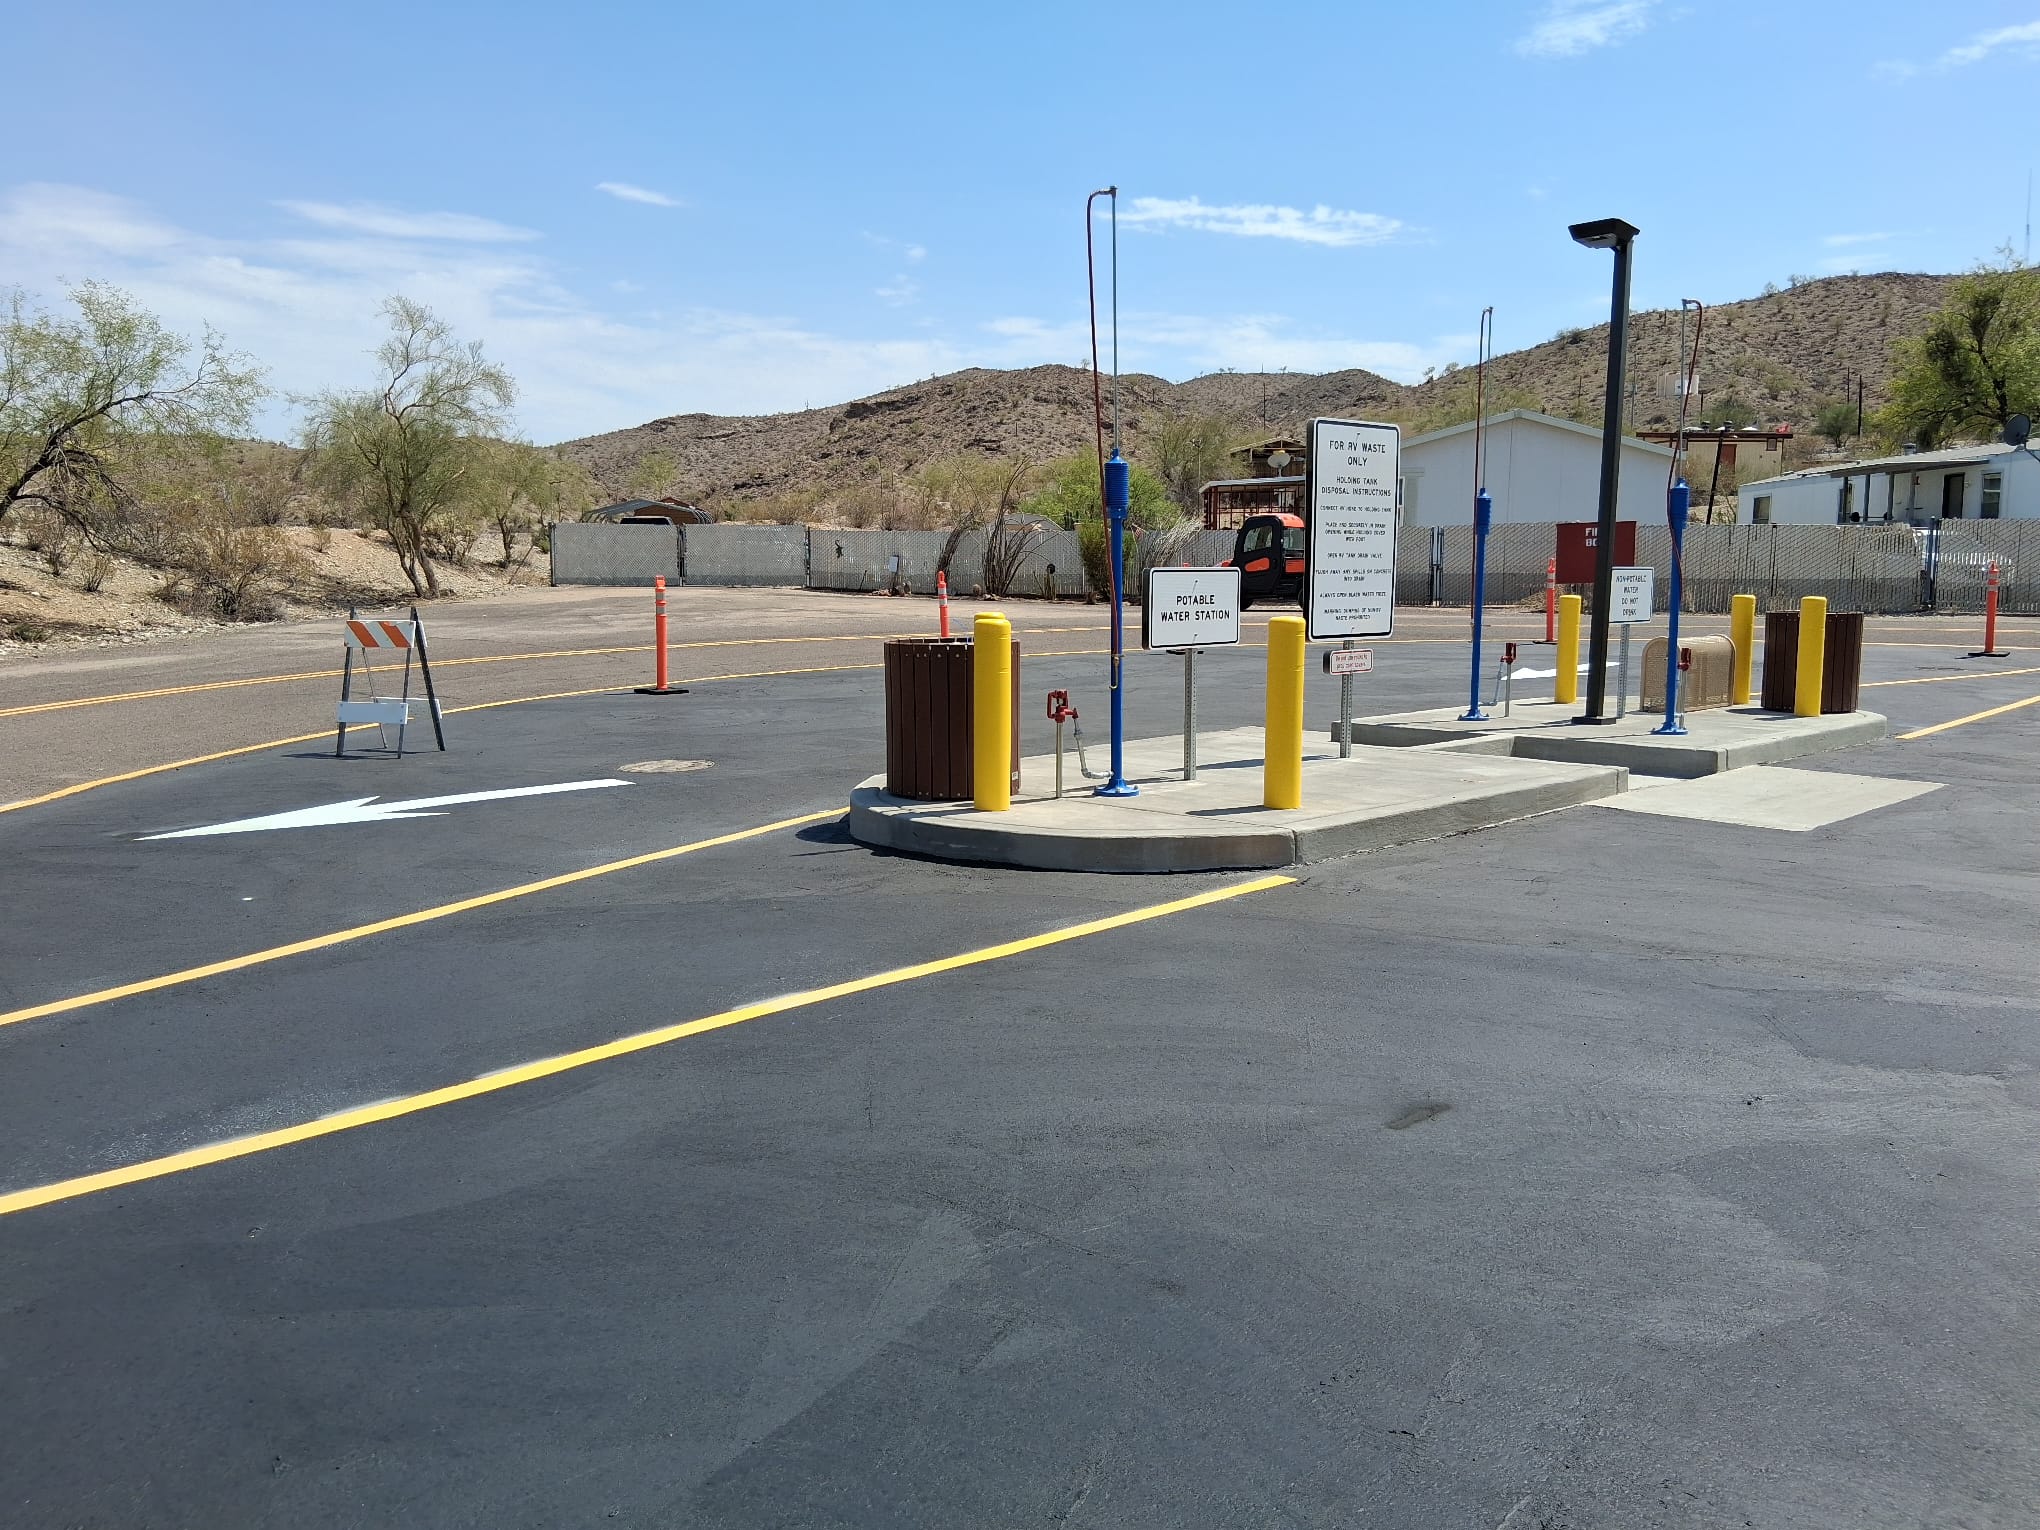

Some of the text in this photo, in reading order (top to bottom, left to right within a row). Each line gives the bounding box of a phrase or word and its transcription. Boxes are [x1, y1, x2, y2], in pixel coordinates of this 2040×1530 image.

[1329, 440, 1386, 453] FOR RV WASTE
[1347, 456, 1368, 466] ONLY
[1336, 475, 1378, 486] HOLDING TANK
[1321, 486, 1391, 497] DISPOSAL INSTRUCTIONS
[1615, 575, 1647, 583] NON-POTABLE
[1623, 586, 1639, 594] WATER
[1176, 594, 1215, 606] POTABLE
[1621, 597, 1628, 605] DO
[1160, 609, 1230, 622] WATER STATION
